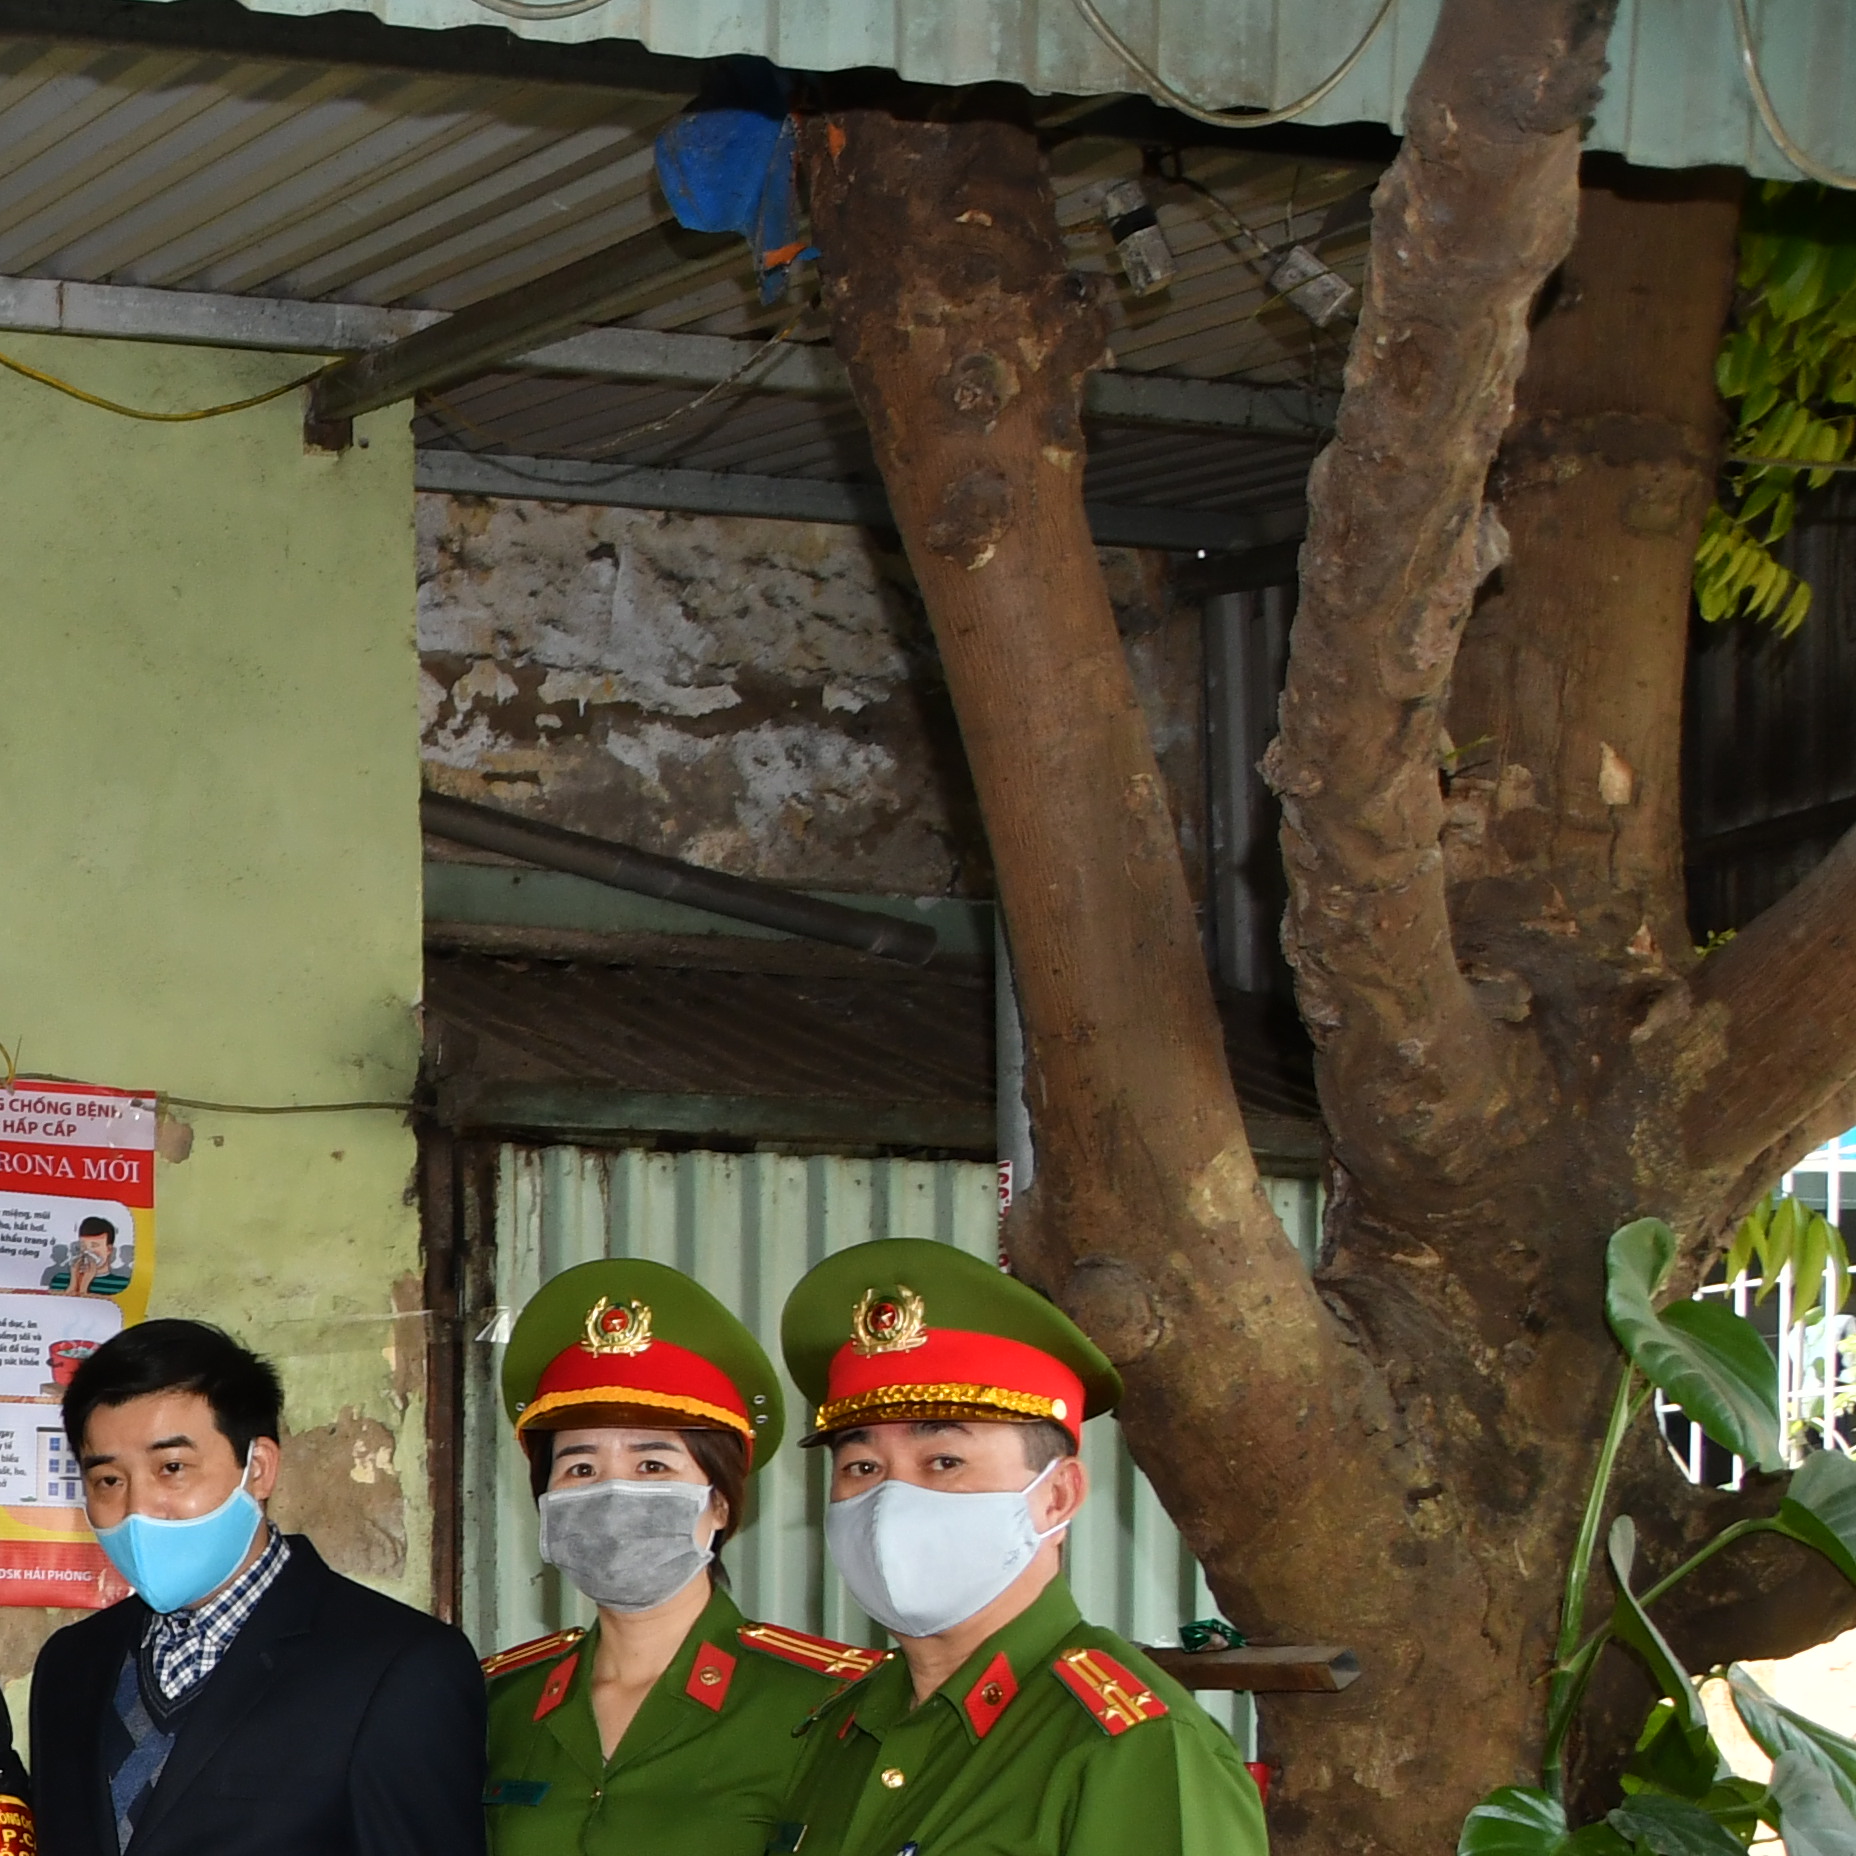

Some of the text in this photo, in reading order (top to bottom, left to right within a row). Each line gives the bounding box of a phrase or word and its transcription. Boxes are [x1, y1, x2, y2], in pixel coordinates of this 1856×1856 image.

[9, 1092, 72, 1116] CHỐNG
[2, 1116, 38, 1135] HẤP
[42, 1118, 77, 1137] CẤP
[82, 1155, 140, 1184] MỚI
[1, 1829, 38, 1850] P.C
